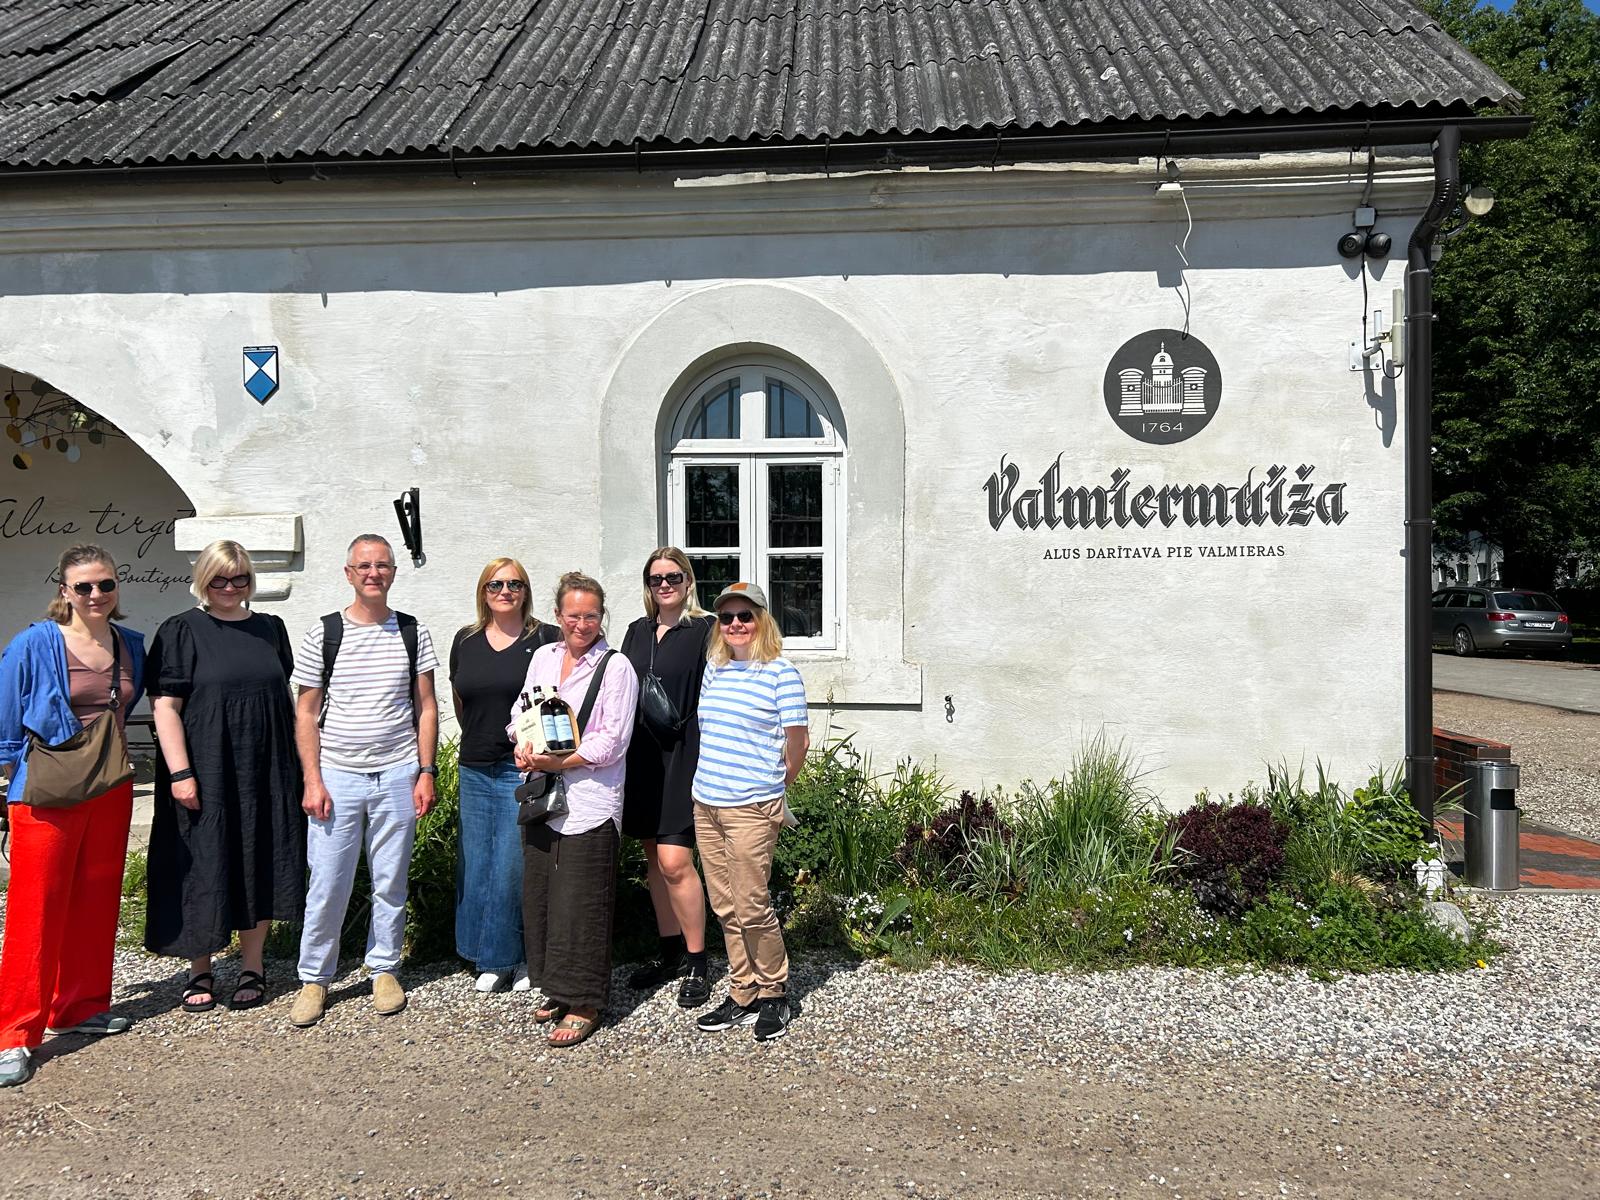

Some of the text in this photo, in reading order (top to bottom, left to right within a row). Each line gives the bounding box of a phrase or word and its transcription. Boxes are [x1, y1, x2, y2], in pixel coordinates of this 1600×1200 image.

[1142, 422, 1184, 433] 1764
[982, 451, 1349, 531] Valmiermuiža
[1043, 545, 1285, 560] ALUS DARĪTAVA PIE VALMIERAS
[116, 564, 193, 593] Boutique
